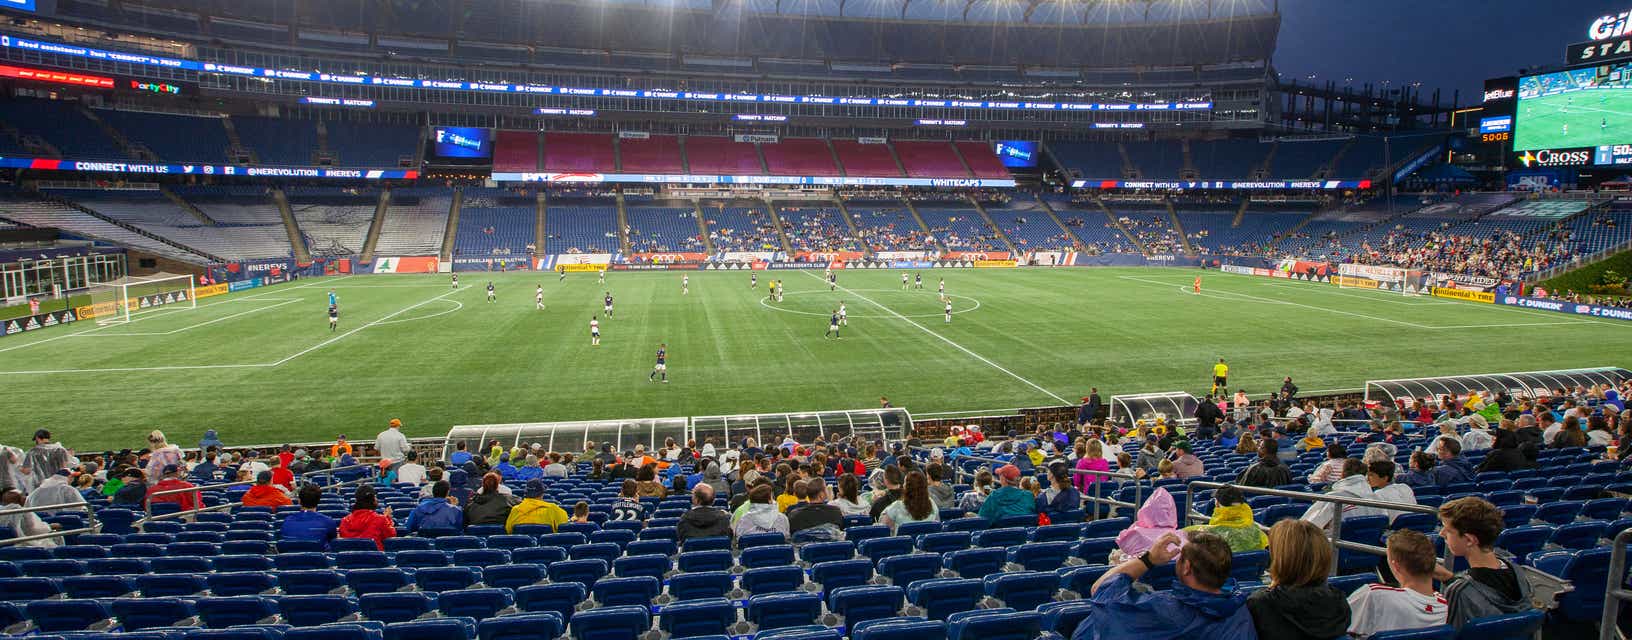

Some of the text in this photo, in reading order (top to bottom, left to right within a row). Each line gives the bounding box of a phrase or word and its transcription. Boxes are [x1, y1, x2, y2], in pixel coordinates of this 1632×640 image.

[1581, 40, 1631, 59] STA
[1483, 89, 1515, 102] jetBlue
[76, 161, 168, 174] CONNECT WITH US
[247, 167, 319, 177] @NEREVOLUTION
[933, 178, 979, 187] WHITECAPS
[1124, 181, 1154, 189] CONNECT
[1433, 287, 1471, 299] Continental
[1526, 299, 1563, 311] DUNKIN'
[614, 508, 638, 522] 22
